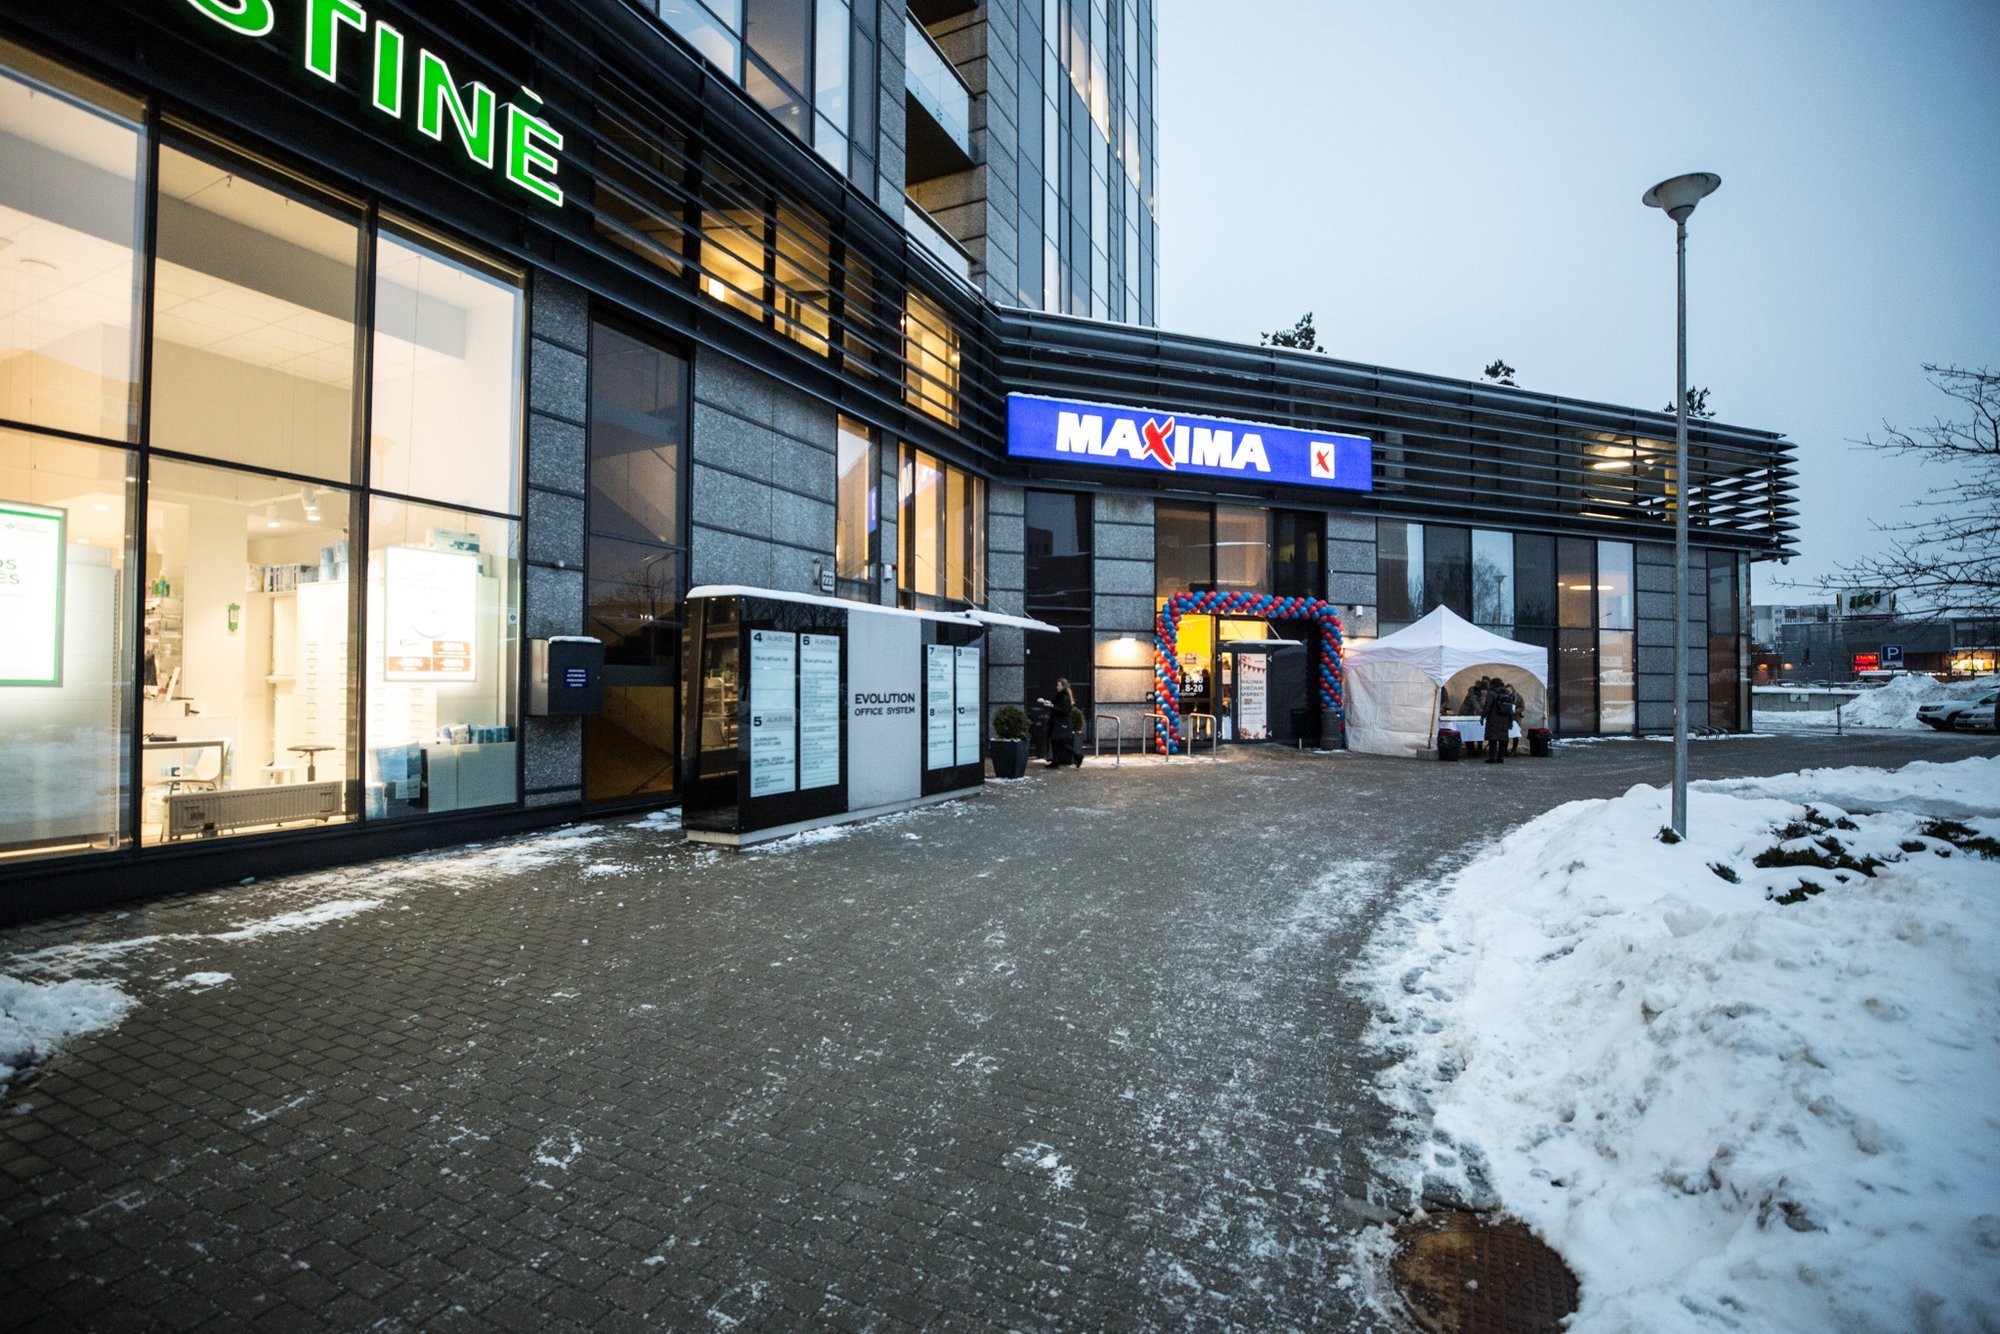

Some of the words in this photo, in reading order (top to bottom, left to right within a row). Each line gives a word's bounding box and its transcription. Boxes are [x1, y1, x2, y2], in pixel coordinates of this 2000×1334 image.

[1055, 411, 1272, 471] MAXIMA
[823, 574, 833, 587] 223
[753, 632, 762, 642] 4
[803, 636, 810, 646] 6
[929, 647, 935, 655] 7
[957, 648, 962, 656] 9
[1887, 647, 1899, 660] P
[1185, 684, 1203, 692] 8-20
[854, 693, 915, 704] EVOLUTION
[854, 707, 883, 716] OFFICE
[886, 706, 915, 715] SYSTEM
[929, 708, 935, 716] 8
[957, 706, 965, 714] 10
[753, 716, 762, 726] 5
